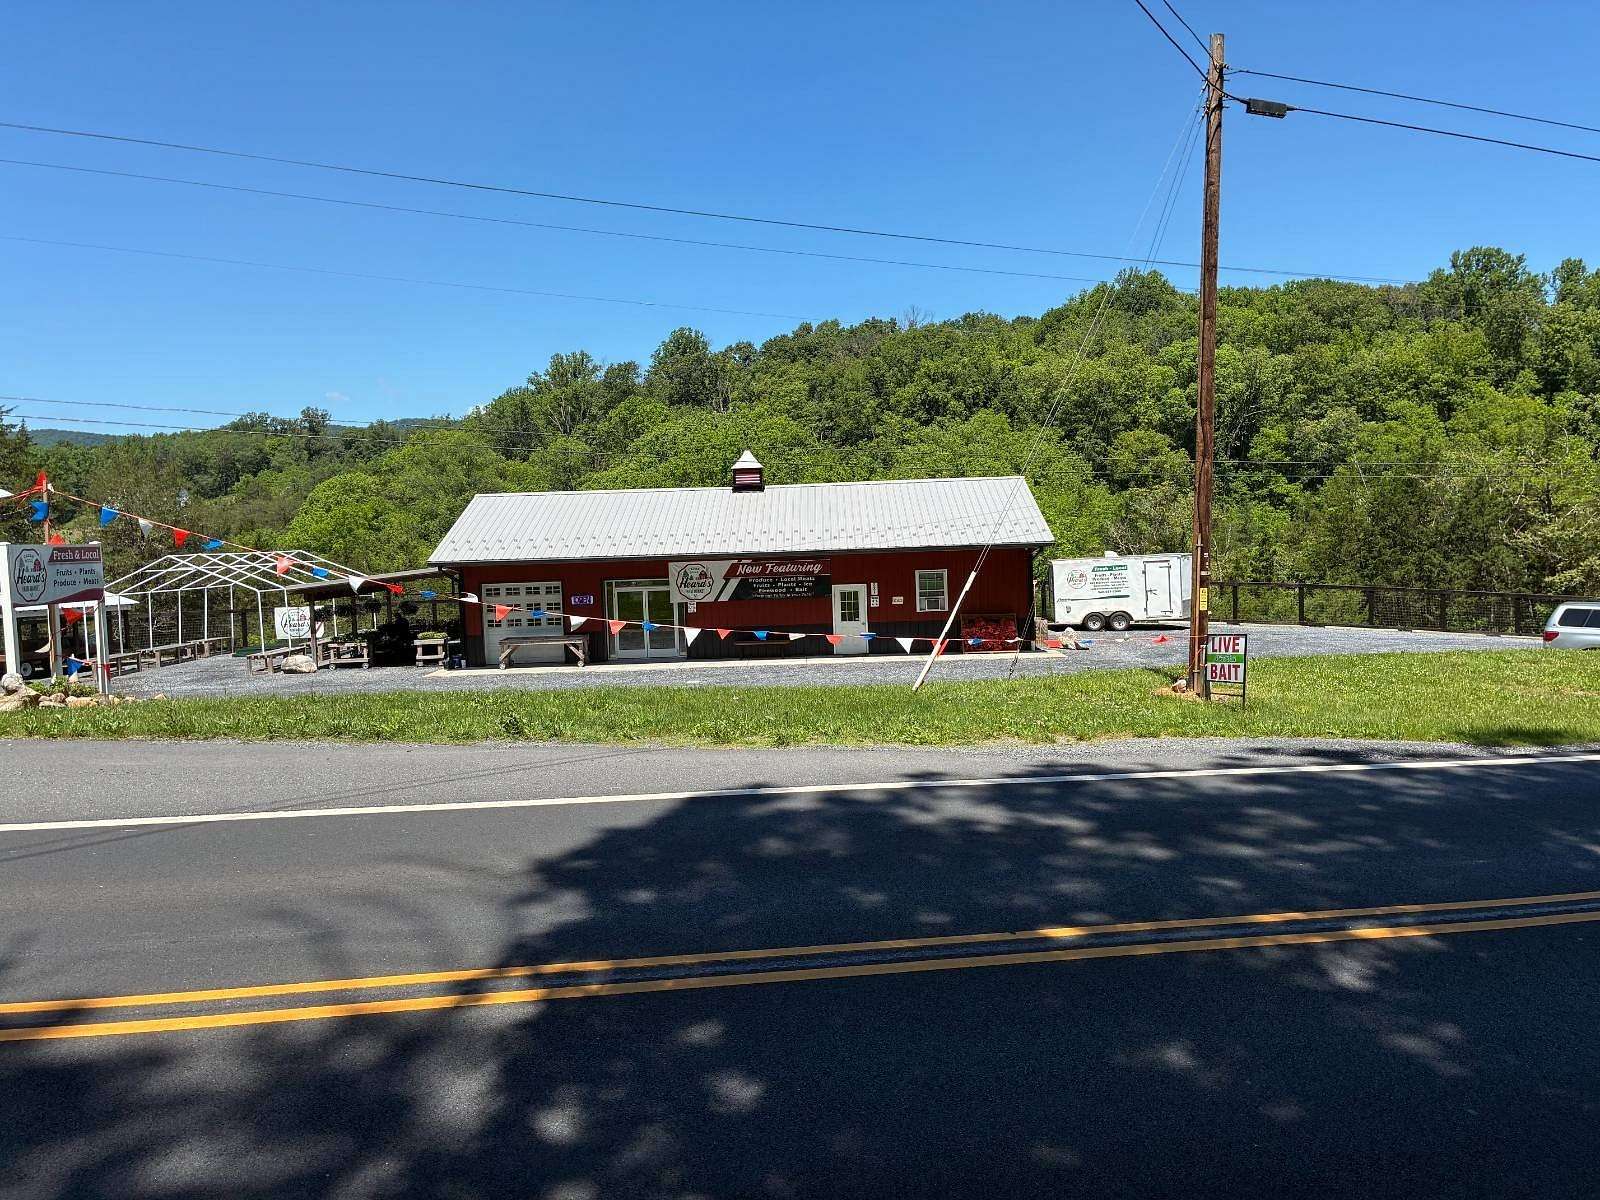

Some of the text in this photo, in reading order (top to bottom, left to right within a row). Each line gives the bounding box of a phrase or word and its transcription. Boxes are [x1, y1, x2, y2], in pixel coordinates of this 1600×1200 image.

[53, 549, 100, 560] Fresh & Local
[56, 567, 96, 576] Fruits Plants
[736, 562, 823, 575] Now Featuring
[53, 579, 77, 587] Produce
[680, 577, 712, 588] Heard's
[1211, 636, 1240, 653] LIVE
[1210, 664, 1240, 681] BAIT
